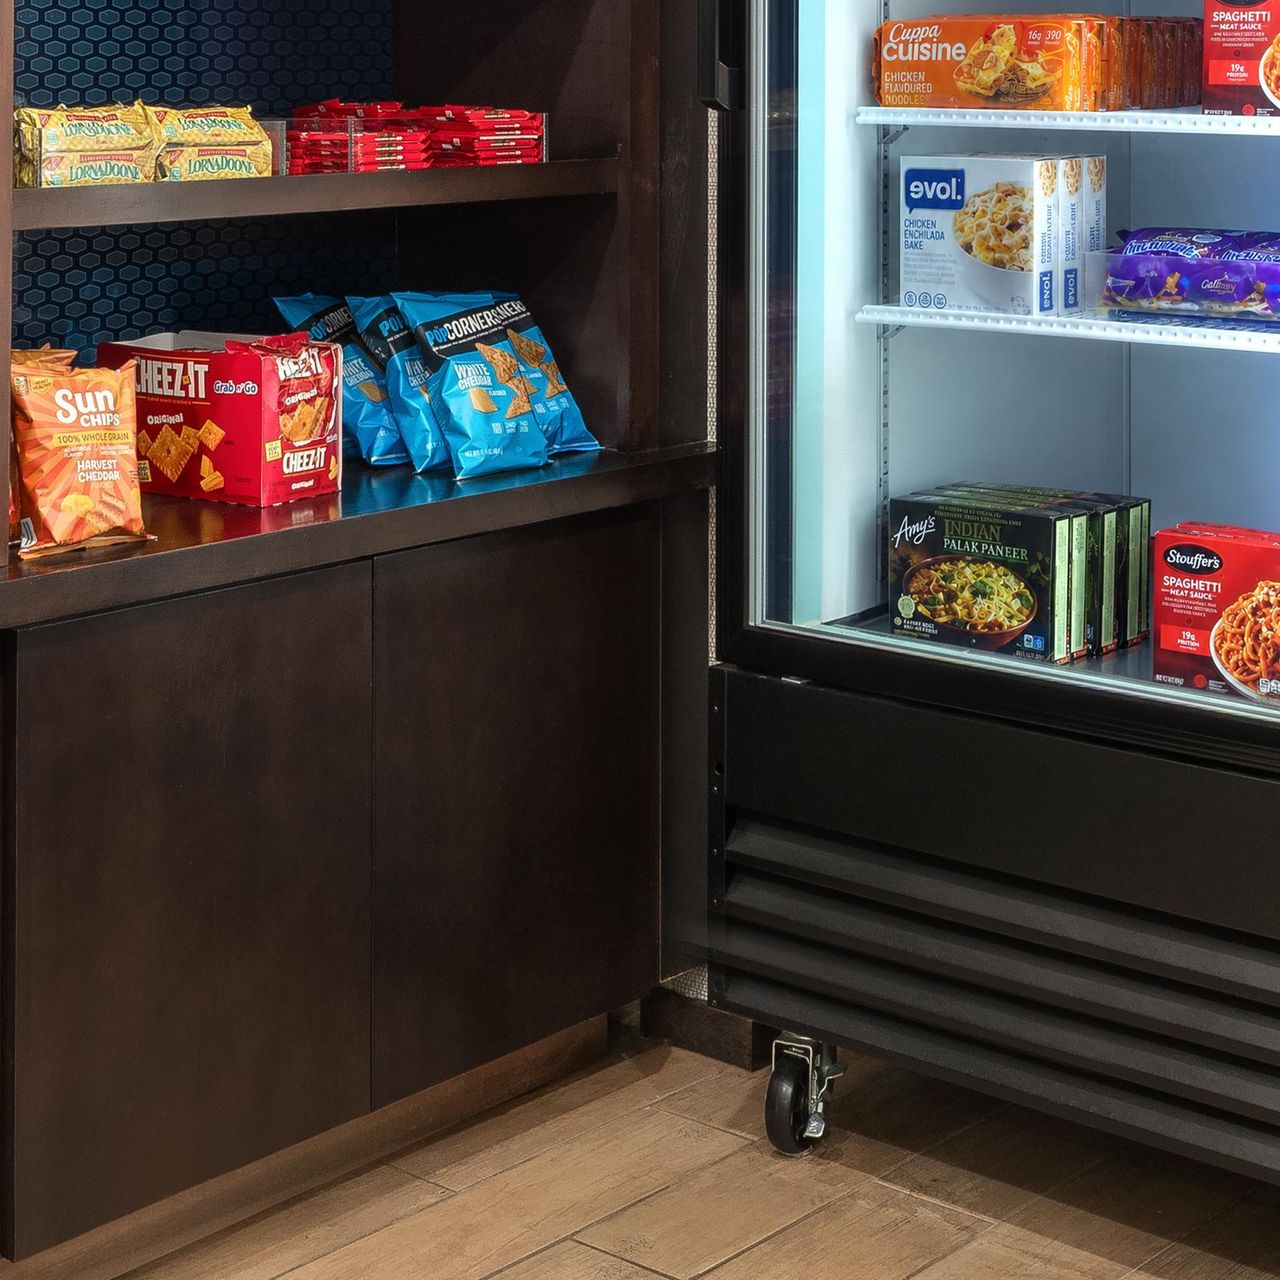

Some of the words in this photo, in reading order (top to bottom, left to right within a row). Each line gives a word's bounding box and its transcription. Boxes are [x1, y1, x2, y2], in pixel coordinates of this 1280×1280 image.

[1213, 11, 1270, 22] SPAGHETTI
[889, 23, 942, 43] Cuppa
[882, 40, 966, 61] cuisine
[885, 72, 925, 82] CHICKEN
[885, 82, 932, 93] FLAVOURED
[904, 219, 937, 229] CHICKEN
[904, 230, 945, 241] ENCHILADA
[904, 240, 923, 250] BAKE
[454, 363, 488, 378] WHITE
[214, 381, 233, 393] Grab
[244, 382, 257, 393] Go
[458, 375, 492, 390] CHEDDAR
[54, 387, 115, 424] Sun
[80, 414, 120, 427] CHIPS
[58, 434, 80, 444] 100%
[77, 460, 117, 470] HARVEST
[78, 472, 120, 482] CHEDDAR
[891, 515, 936, 548] Amy's
[944, 520, 1001, 541] INDIAN
[944, 538, 979, 553] PALAK
[982, 545, 1028, 561] PANEER
[1167, 549, 1220, 569] Stouffer's
[1163, 576, 1221, 593] SPAGHETTI
